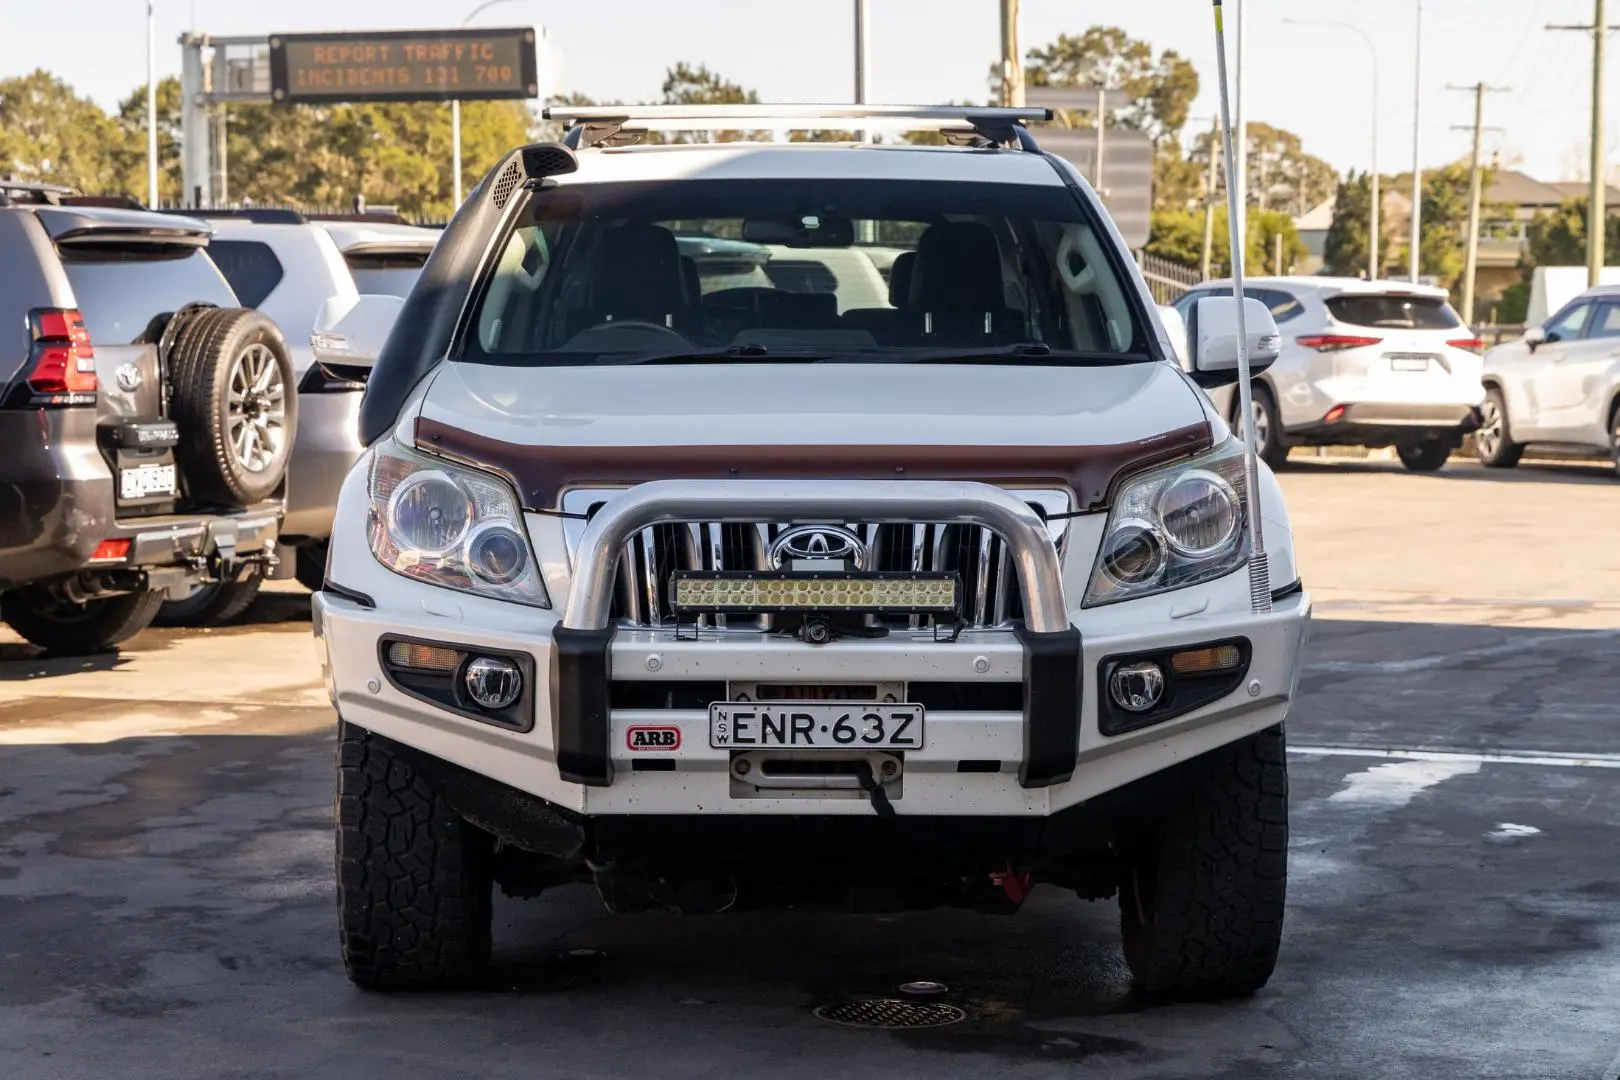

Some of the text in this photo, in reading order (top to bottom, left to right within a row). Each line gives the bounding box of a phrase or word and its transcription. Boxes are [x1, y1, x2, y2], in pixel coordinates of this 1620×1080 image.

[314, 42, 494, 63] REPORT TRAFFIC
[297, 64, 512, 86] INCIDENTS 131 700
[633, 731, 676, 746] ARB
